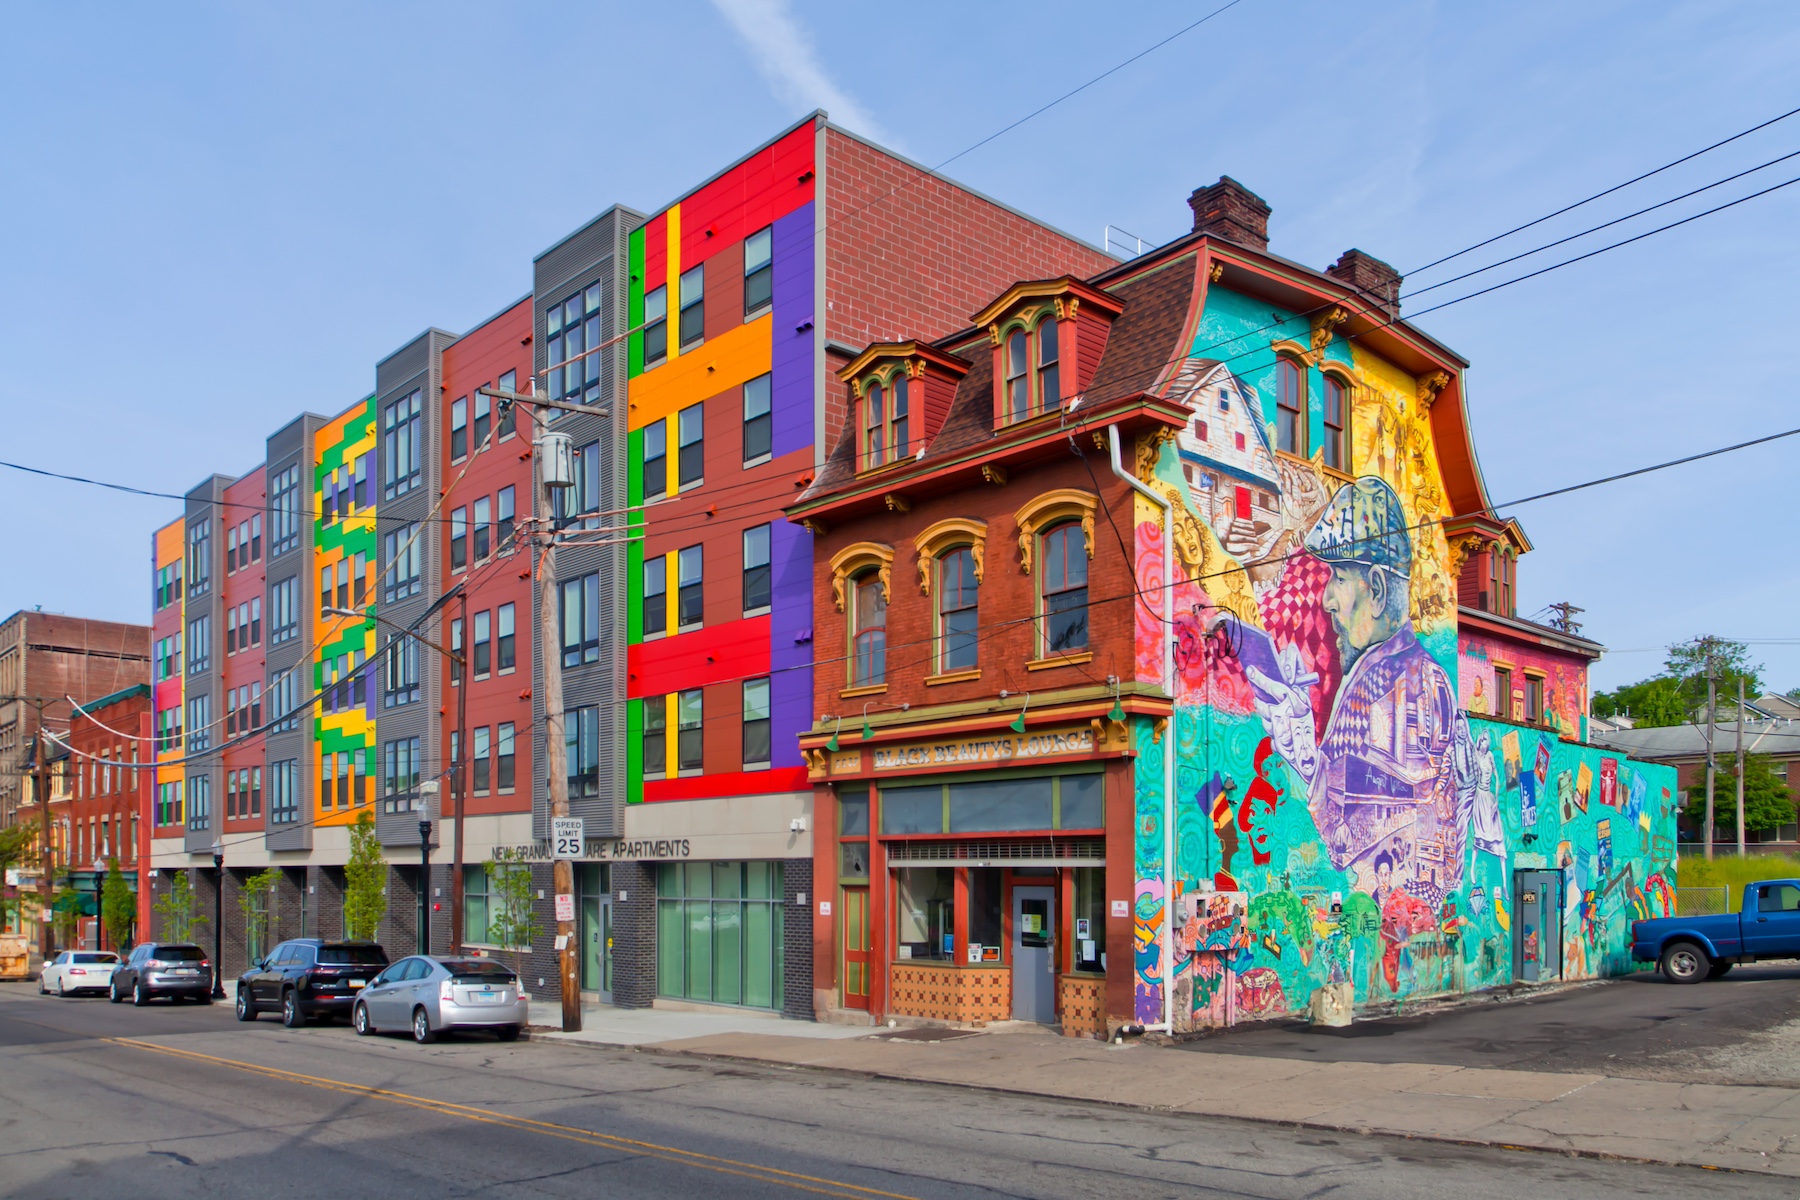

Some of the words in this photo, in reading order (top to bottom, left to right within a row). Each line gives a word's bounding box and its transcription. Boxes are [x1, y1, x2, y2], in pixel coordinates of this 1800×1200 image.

[874, 746, 930, 768] BLACK
[1016, 729, 1093, 757] LOUNGE
[555, 821, 582, 829] SPEED
[491, 847, 511, 861] NEW
[612, 839, 690, 858] APARTMENTS
[557, 839, 580, 854] 25
